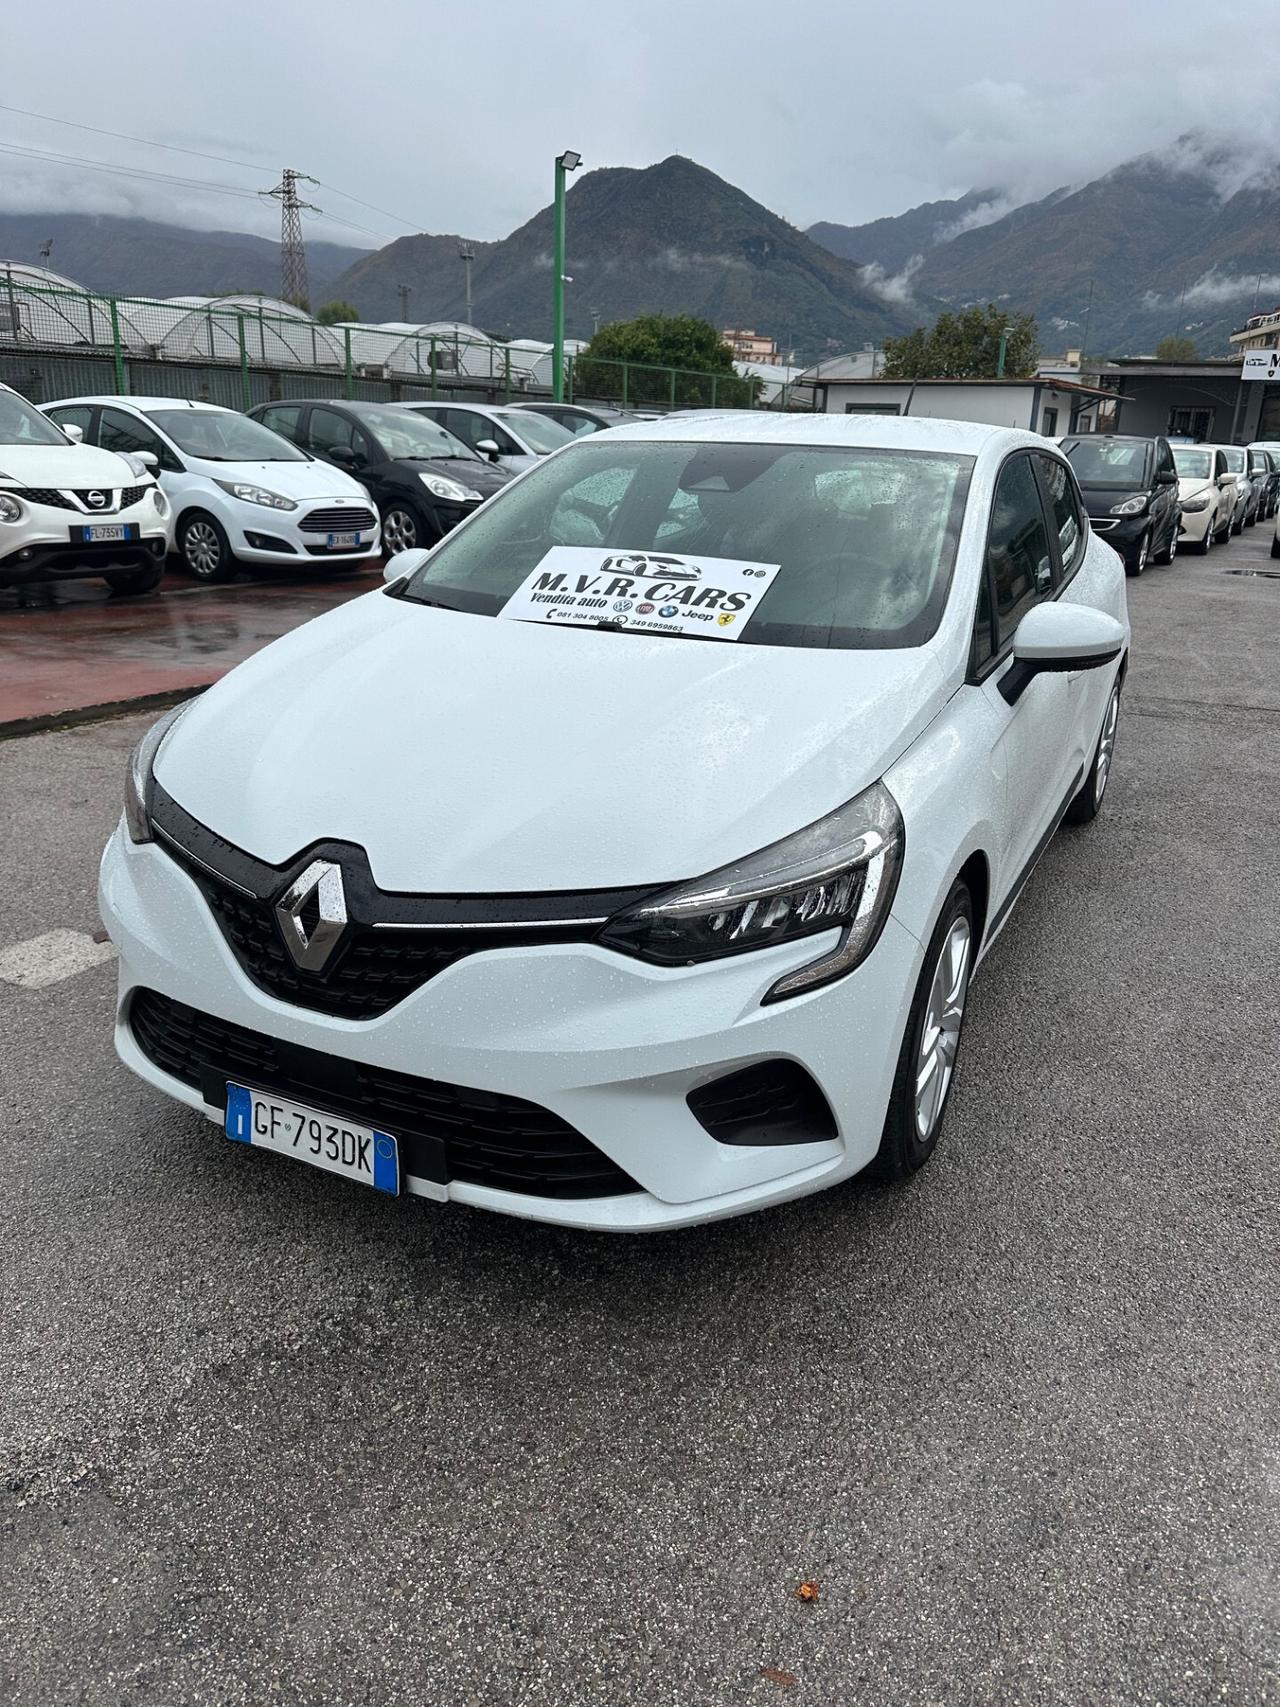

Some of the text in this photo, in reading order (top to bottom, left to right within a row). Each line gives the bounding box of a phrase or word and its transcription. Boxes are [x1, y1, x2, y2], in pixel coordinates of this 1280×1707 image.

[530, 592, 608, 608] Vendita auto
[644, 582, 752, 611] CARS
[630, 619, 646, 627] 349
[682, 610, 714, 622] Jeep
